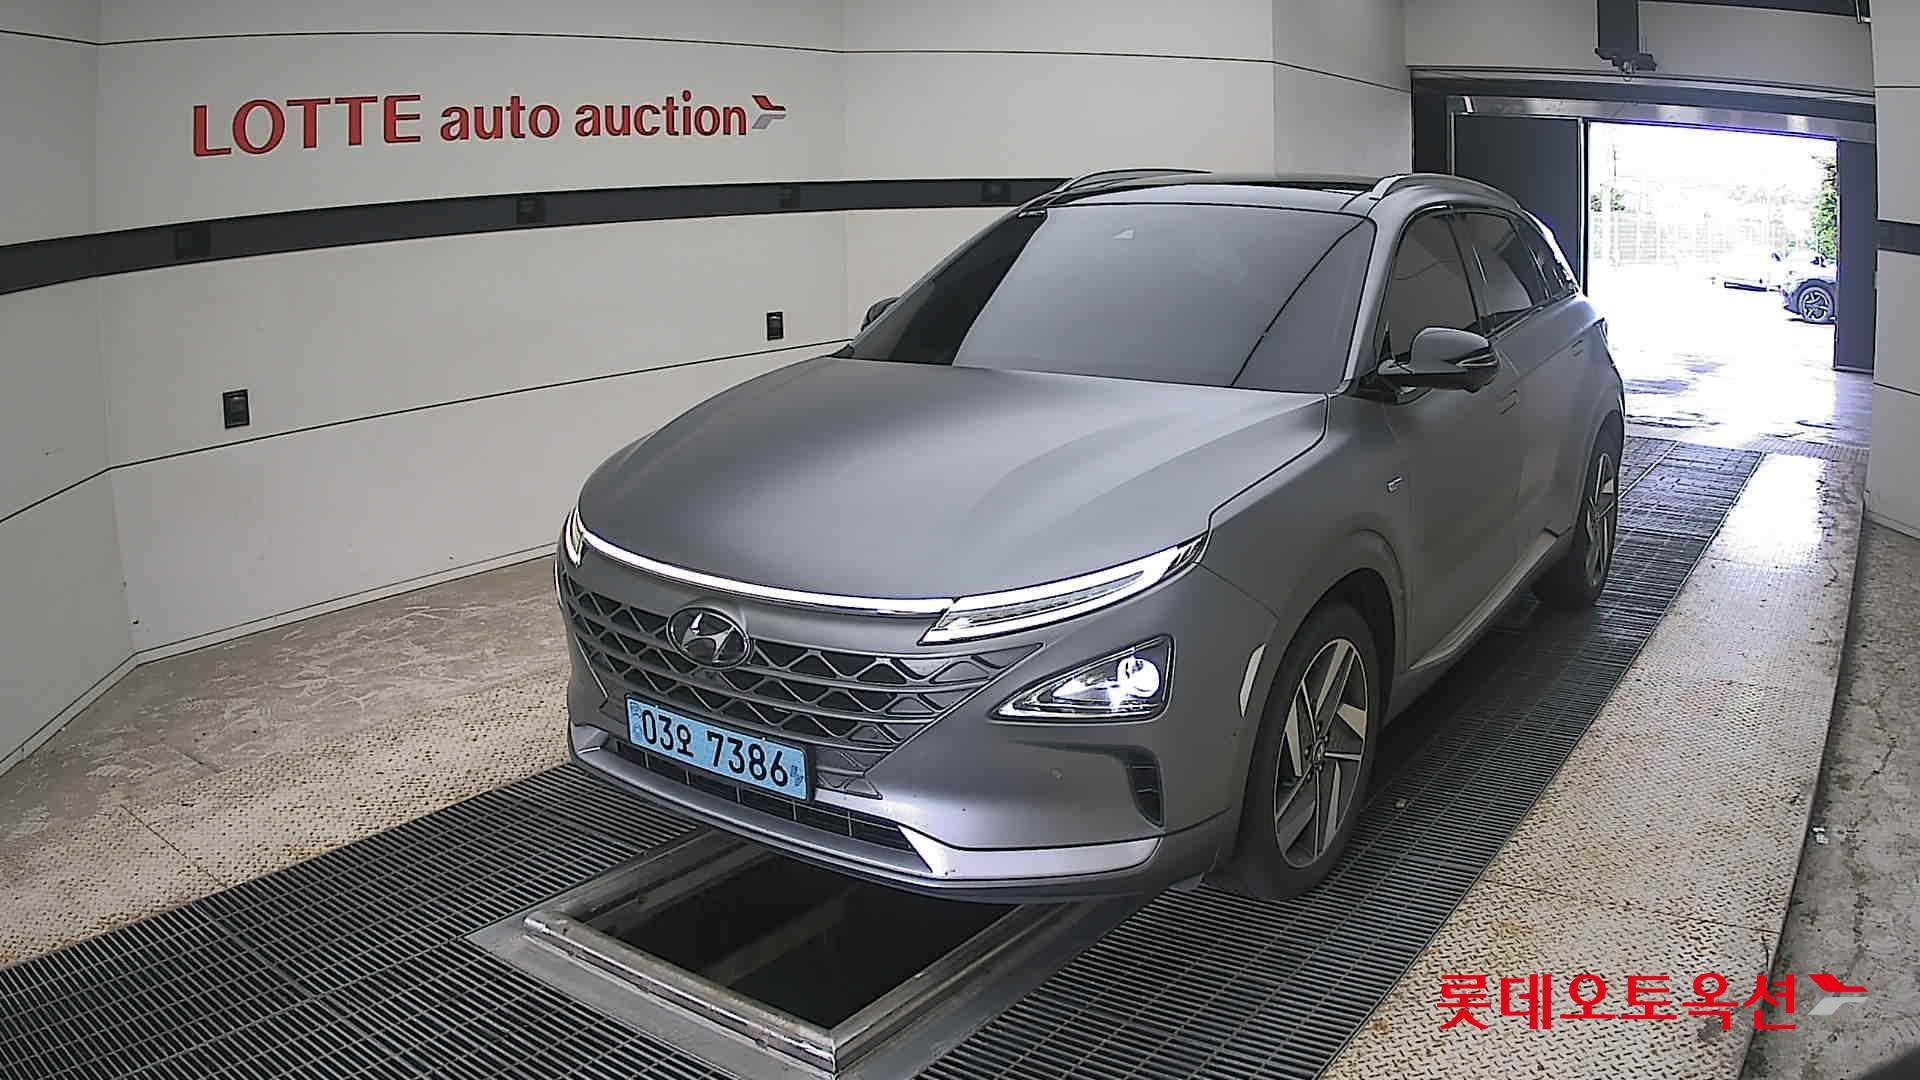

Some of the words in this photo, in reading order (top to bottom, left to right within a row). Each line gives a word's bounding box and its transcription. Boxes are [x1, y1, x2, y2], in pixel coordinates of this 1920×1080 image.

[193, 94, 421, 157] LOTTE
[439, 95, 561, 141] auto
[574, 90, 747, 137] auction
[641, 709, 694, 758] 03오
[706, 730, 788, 788] 7386
